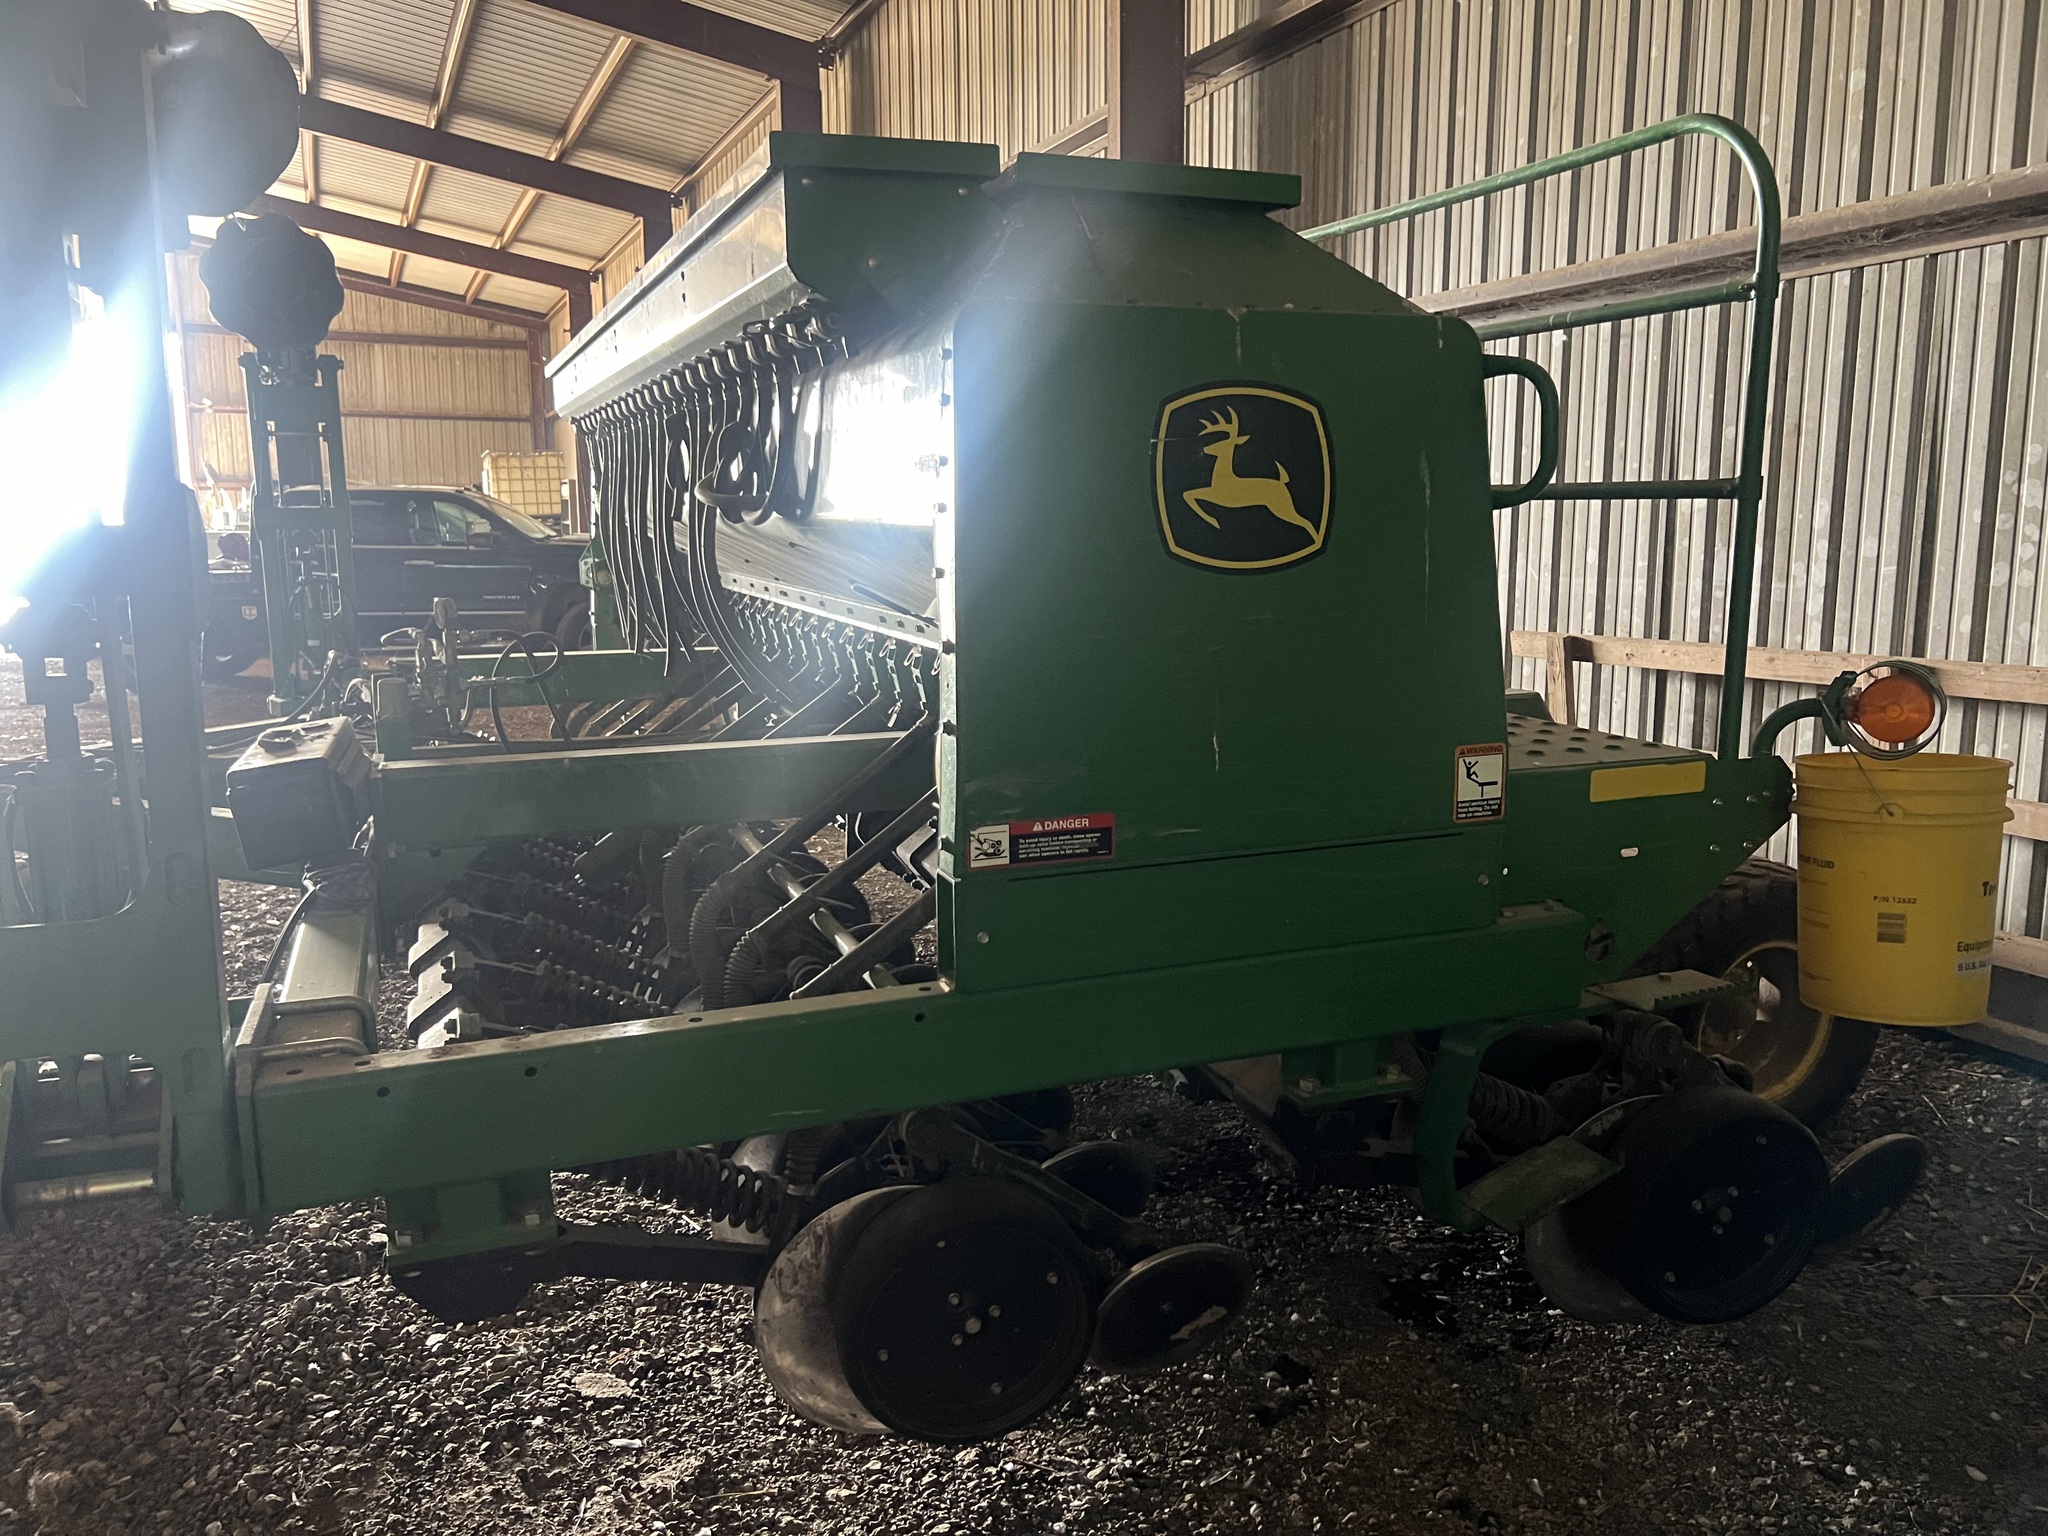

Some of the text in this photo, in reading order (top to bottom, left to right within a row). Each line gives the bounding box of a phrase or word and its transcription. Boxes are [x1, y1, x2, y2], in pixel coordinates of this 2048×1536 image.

[1467, 745, 1502, 754] WARNING
[1044, 818, 1090, 830] DANGER
[1812, 857, 1835, 869] FLUID
[1958, 963, 1964, 971] 5
